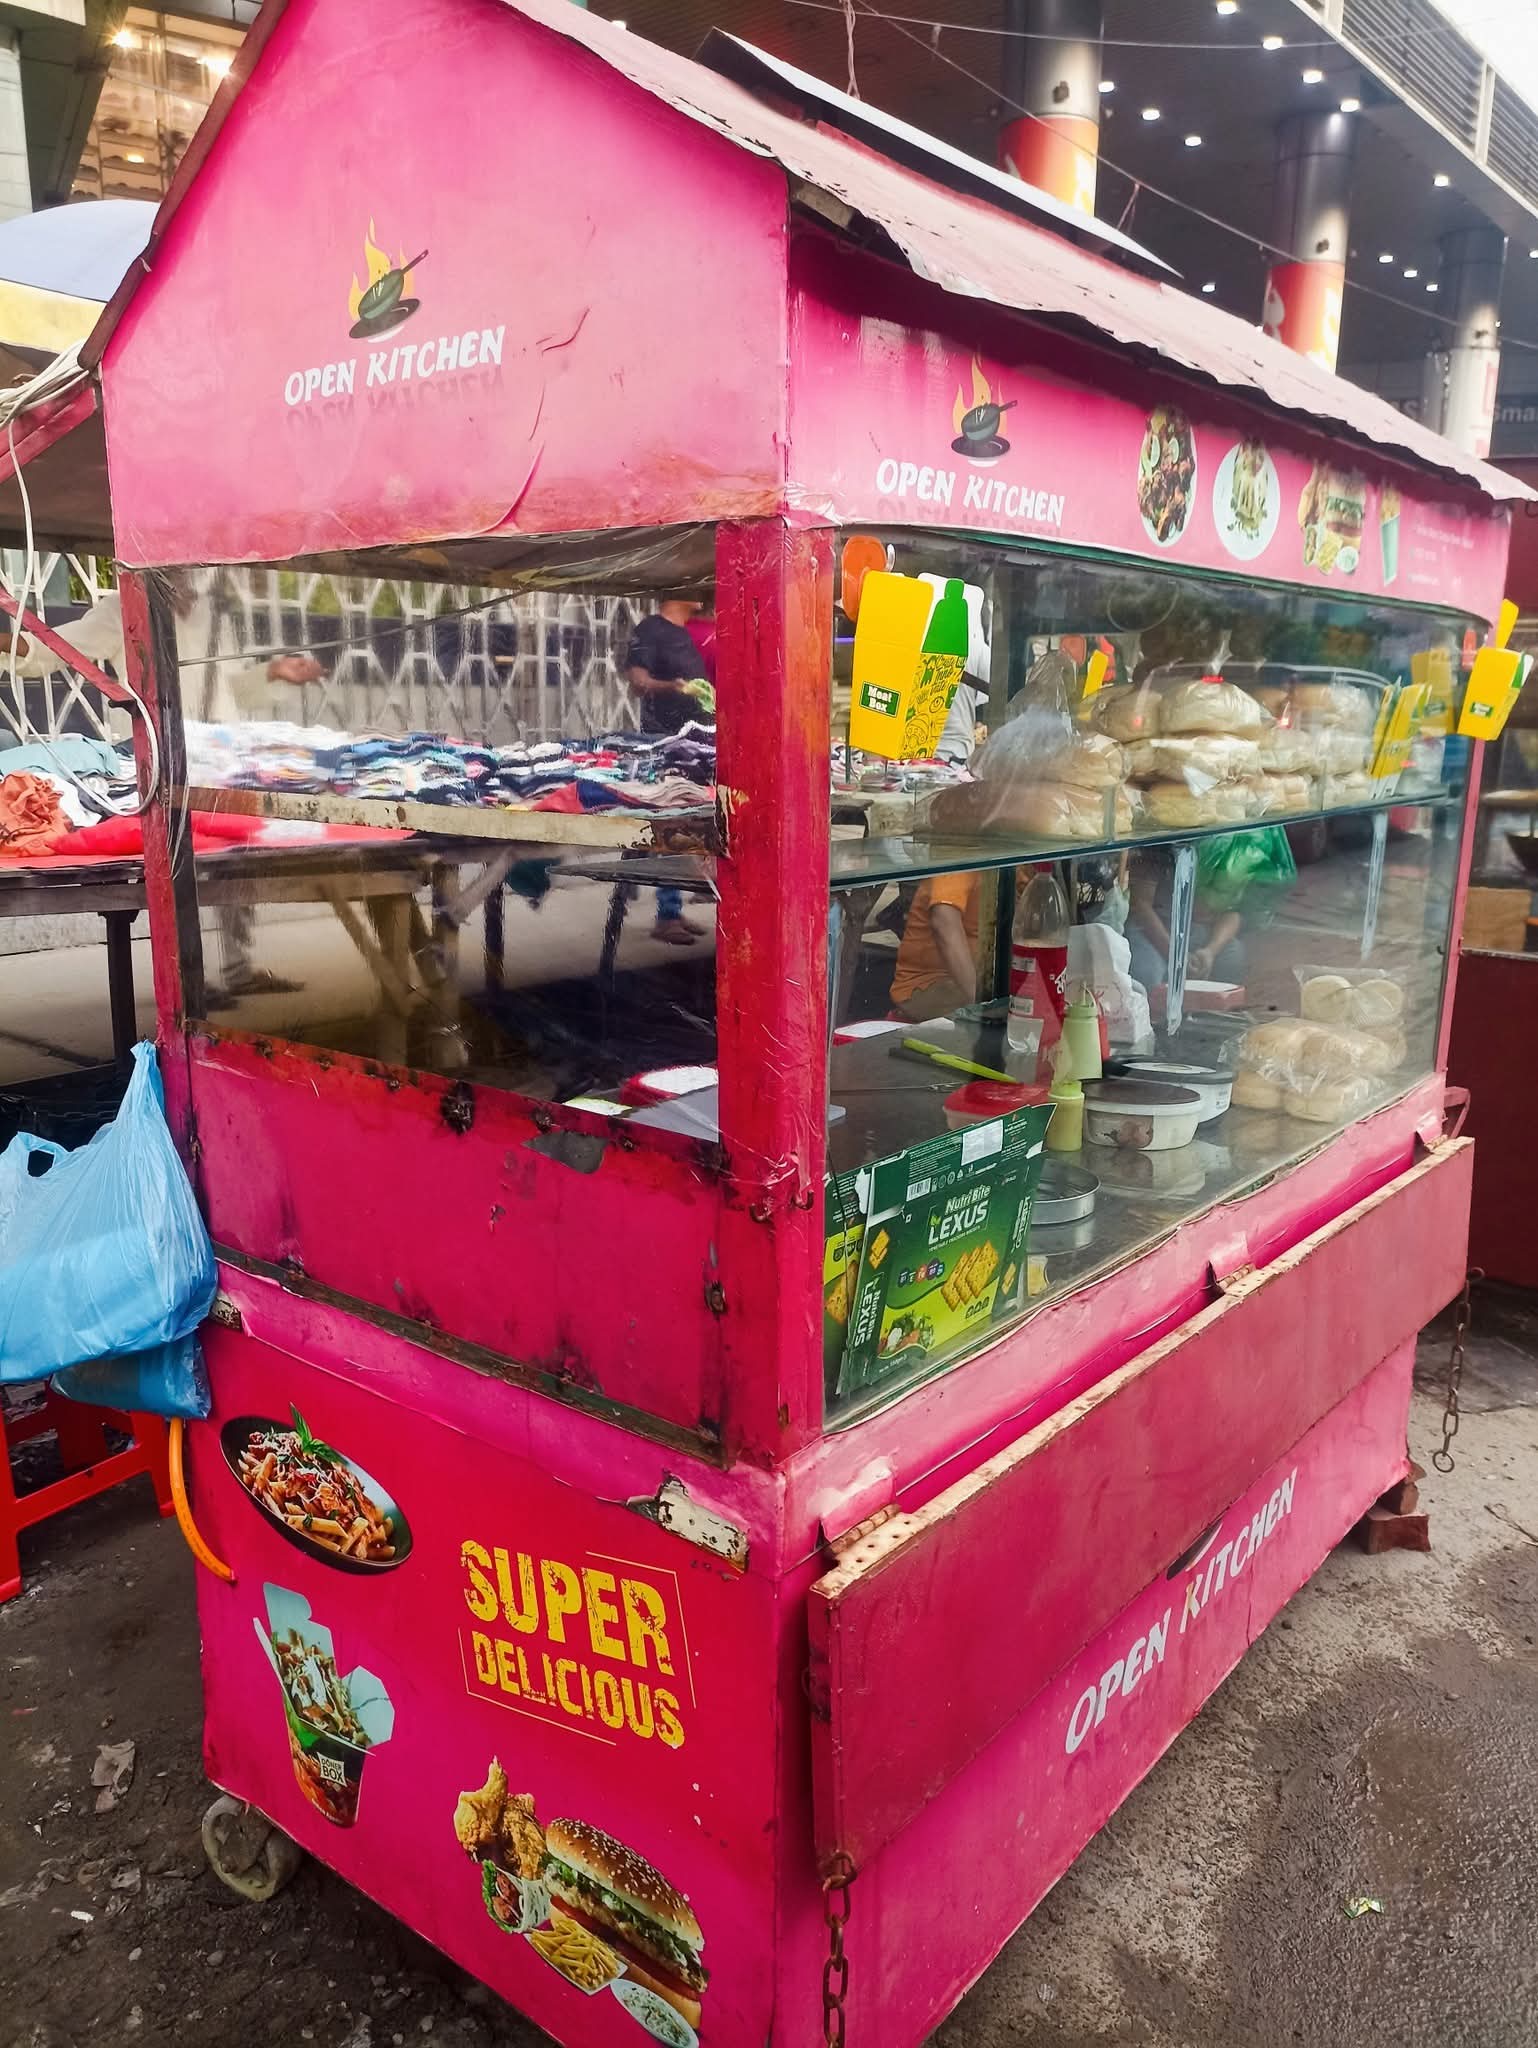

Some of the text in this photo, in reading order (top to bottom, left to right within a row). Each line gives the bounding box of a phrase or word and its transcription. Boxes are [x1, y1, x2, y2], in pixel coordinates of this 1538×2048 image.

[284, 325, 506, 406] OPEN KITCHEN
[876, 458, 1066, 528] OPEN KITCHEN
[867, 686, 892, 702] Meat
[869, 698, 888, 712] Box
[928, 1200, 989, 1245] LEXUS
[854, 1281, 874, 1348] LEXUS
[460, 1539, 675, 1677] SUPER
[1065, 1466, 1298, 1754] OPEN KITCHEN
[472, 1630, 685, 1749] DELICIOUS
[323, 1765, 344, 1784] BOX
